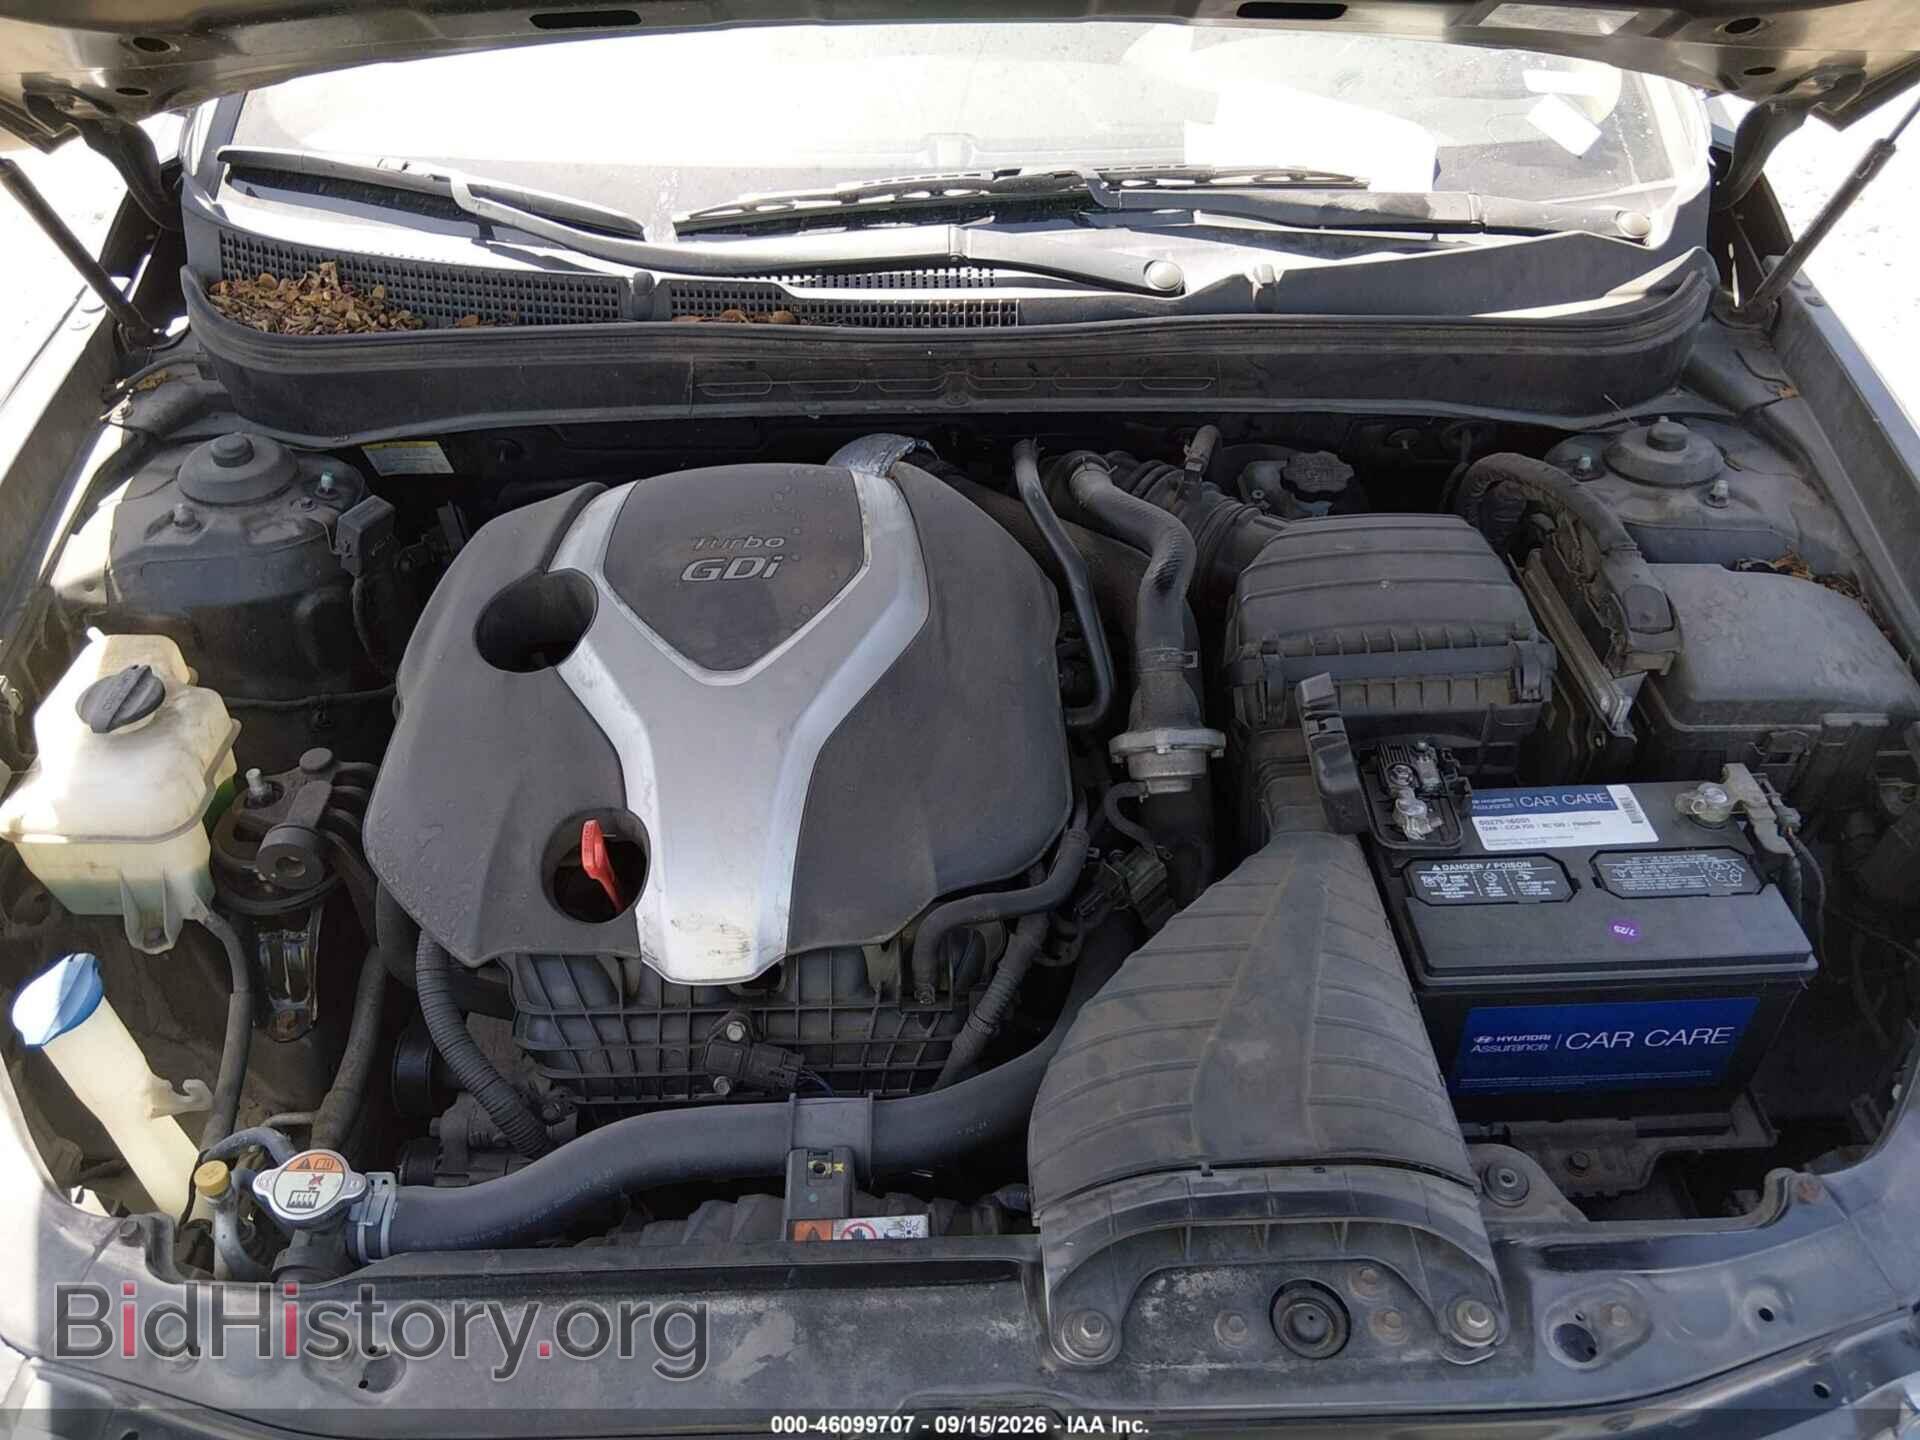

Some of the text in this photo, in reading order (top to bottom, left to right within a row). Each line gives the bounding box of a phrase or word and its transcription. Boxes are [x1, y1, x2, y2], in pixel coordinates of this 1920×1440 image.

[681, 555, 784, 581] GDi
[1519, 796, 1557, 808] CAR
[1561, 792, 1611, 806] CARE
[1441, 862, 1483, 871] DANGER
[1494, 861, 1532, 869] POISON
[1496, 1034, 1552, 1042] HYUNDAI
[1565, 1026, 1735, 1050] CAR CARE
[1470, 1043, 1549, 1053] Assurance
